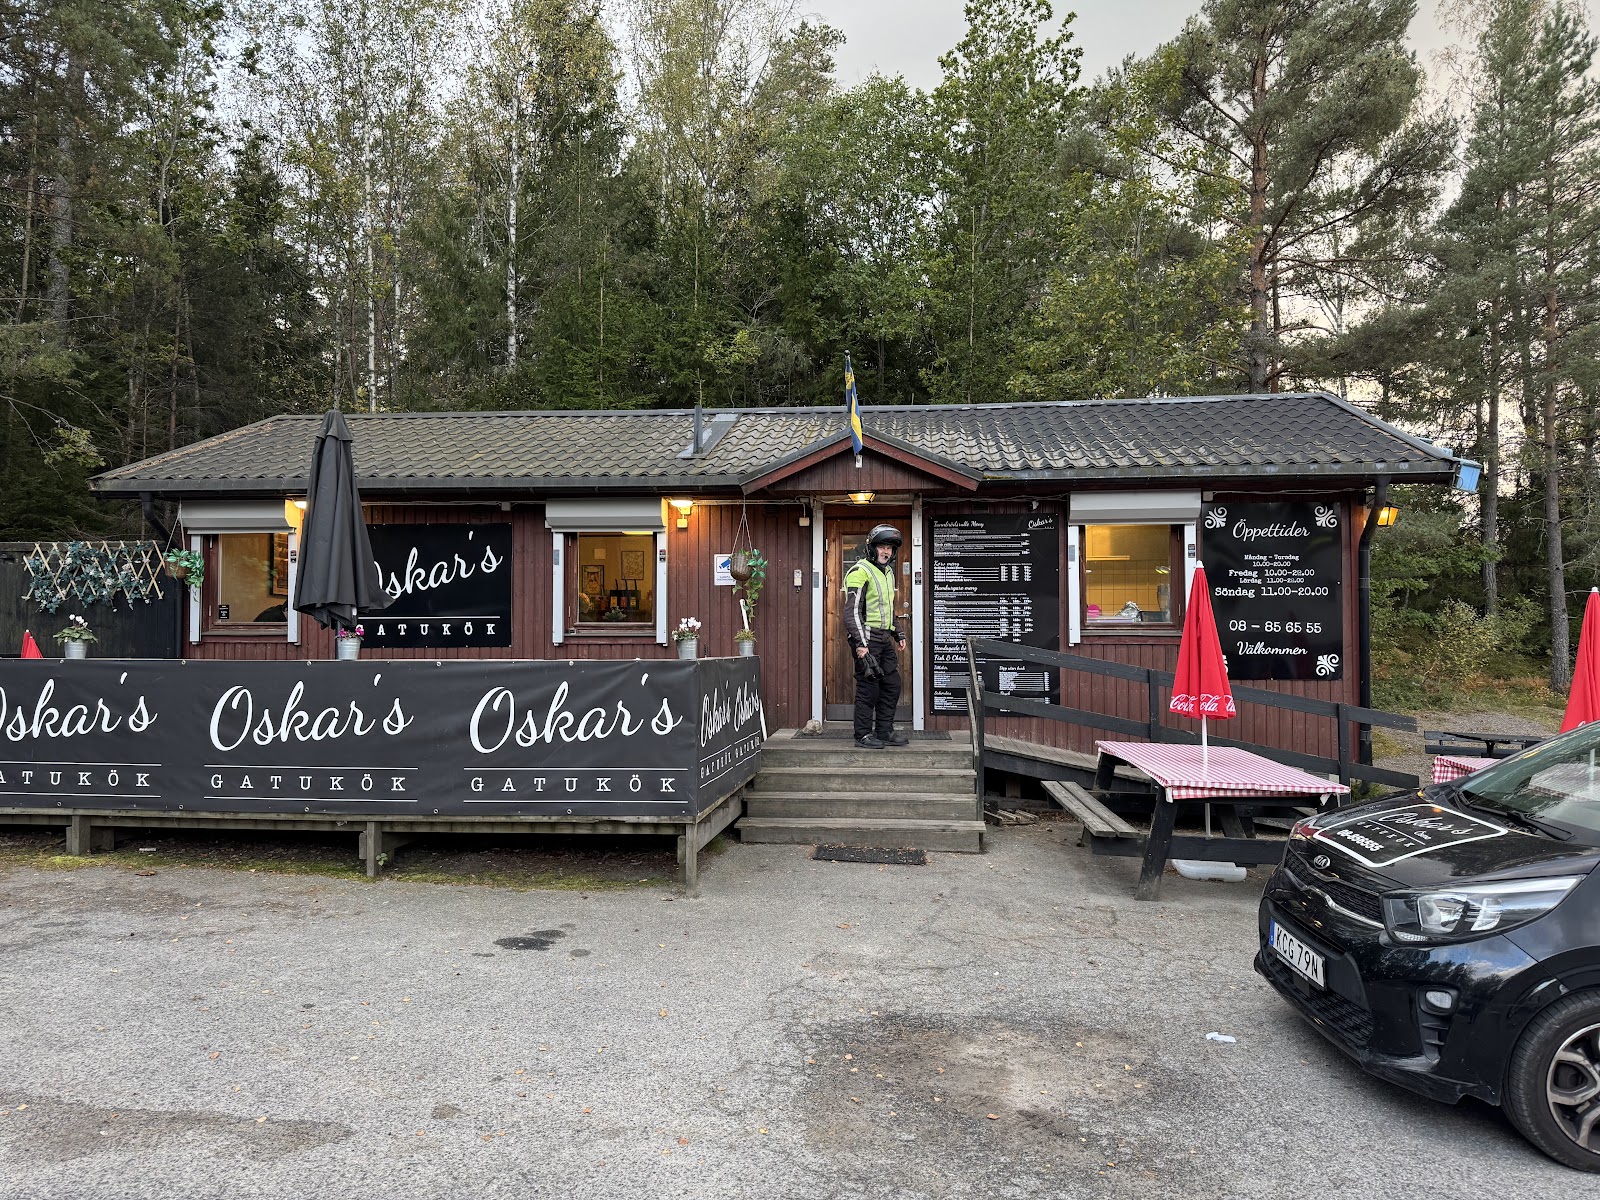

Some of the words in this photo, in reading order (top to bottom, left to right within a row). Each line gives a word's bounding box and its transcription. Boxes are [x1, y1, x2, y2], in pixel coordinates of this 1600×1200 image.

[1232, 519, 1311, 542] Öppettider
[1228, 569, 1258, 578] Fredag
[1239, 577, 1262, 585] Lördag
[1214, 587, 1256, 598] Söndag
[1260, 586, 1329, 596] 11.00-20.00
[1229, 620, 1247, 631] 08
[1264, 621, 1281, 633] 85
[1285, 621, 1302, 633] 65
[1306, 622, 1322, 633] 55
[1236, 641, 1309, 656] Välkommen
[209, 673, 414, 751] Oskar's
[469, 672, 683, 754] Oskar's
[701, 680, 732, 748] Oskar's
[210, 773, 406, 792] GATUKÖK
[470, 774, 675, 792] GATUKÖK
[1378, 812, 1478, 835] Oskar's
[1276, 926, 1295, 960] KCG
[1297, 943, 1319, 980] 79N
